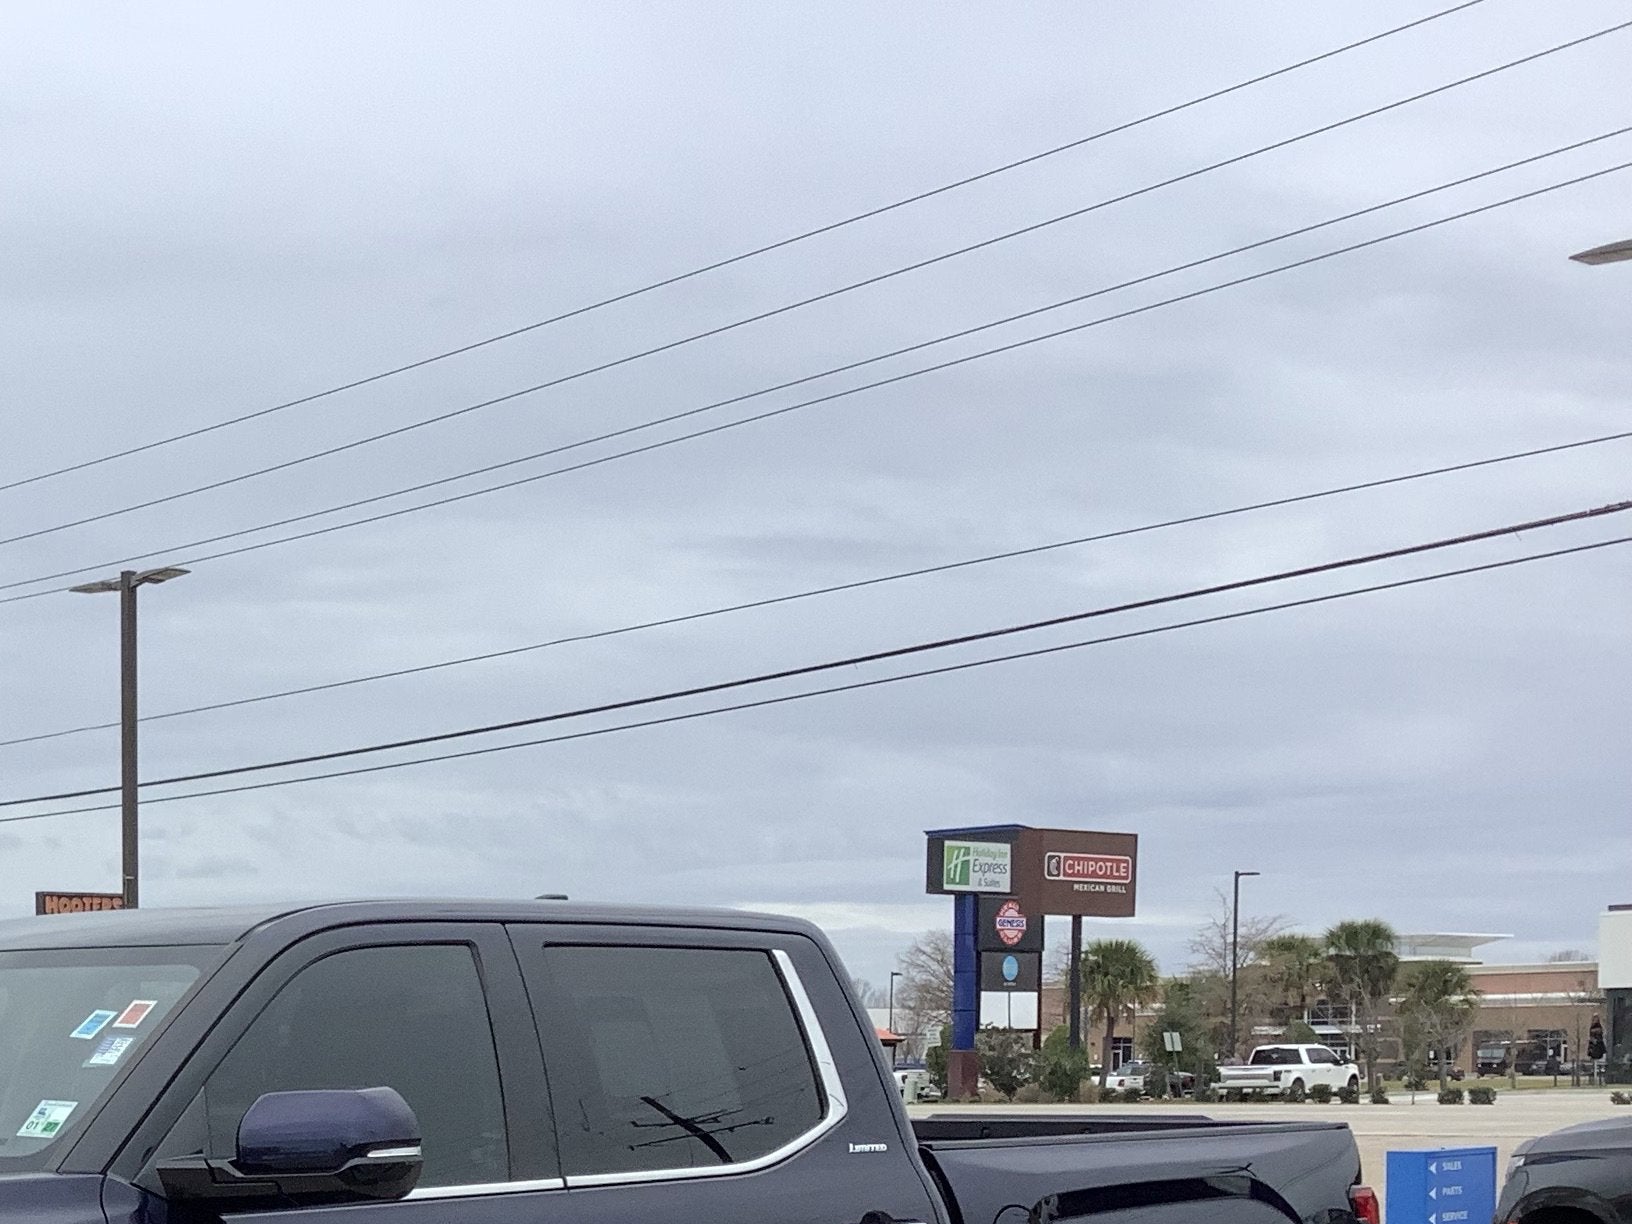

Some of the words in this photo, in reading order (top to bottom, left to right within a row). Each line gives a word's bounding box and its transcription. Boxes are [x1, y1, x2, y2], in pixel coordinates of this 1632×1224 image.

[972, 859, 1008, 876] Express
[1064, 859, 1128, 876] CHIPOTLE
[1073, 884, 1105, 893] MEXICAN
[1106, 885, 1127, 893] GRILL
[1442, 1186, 1463, 1196] PARTS
[1442, 1210, 1468, 1221] SERVICE
